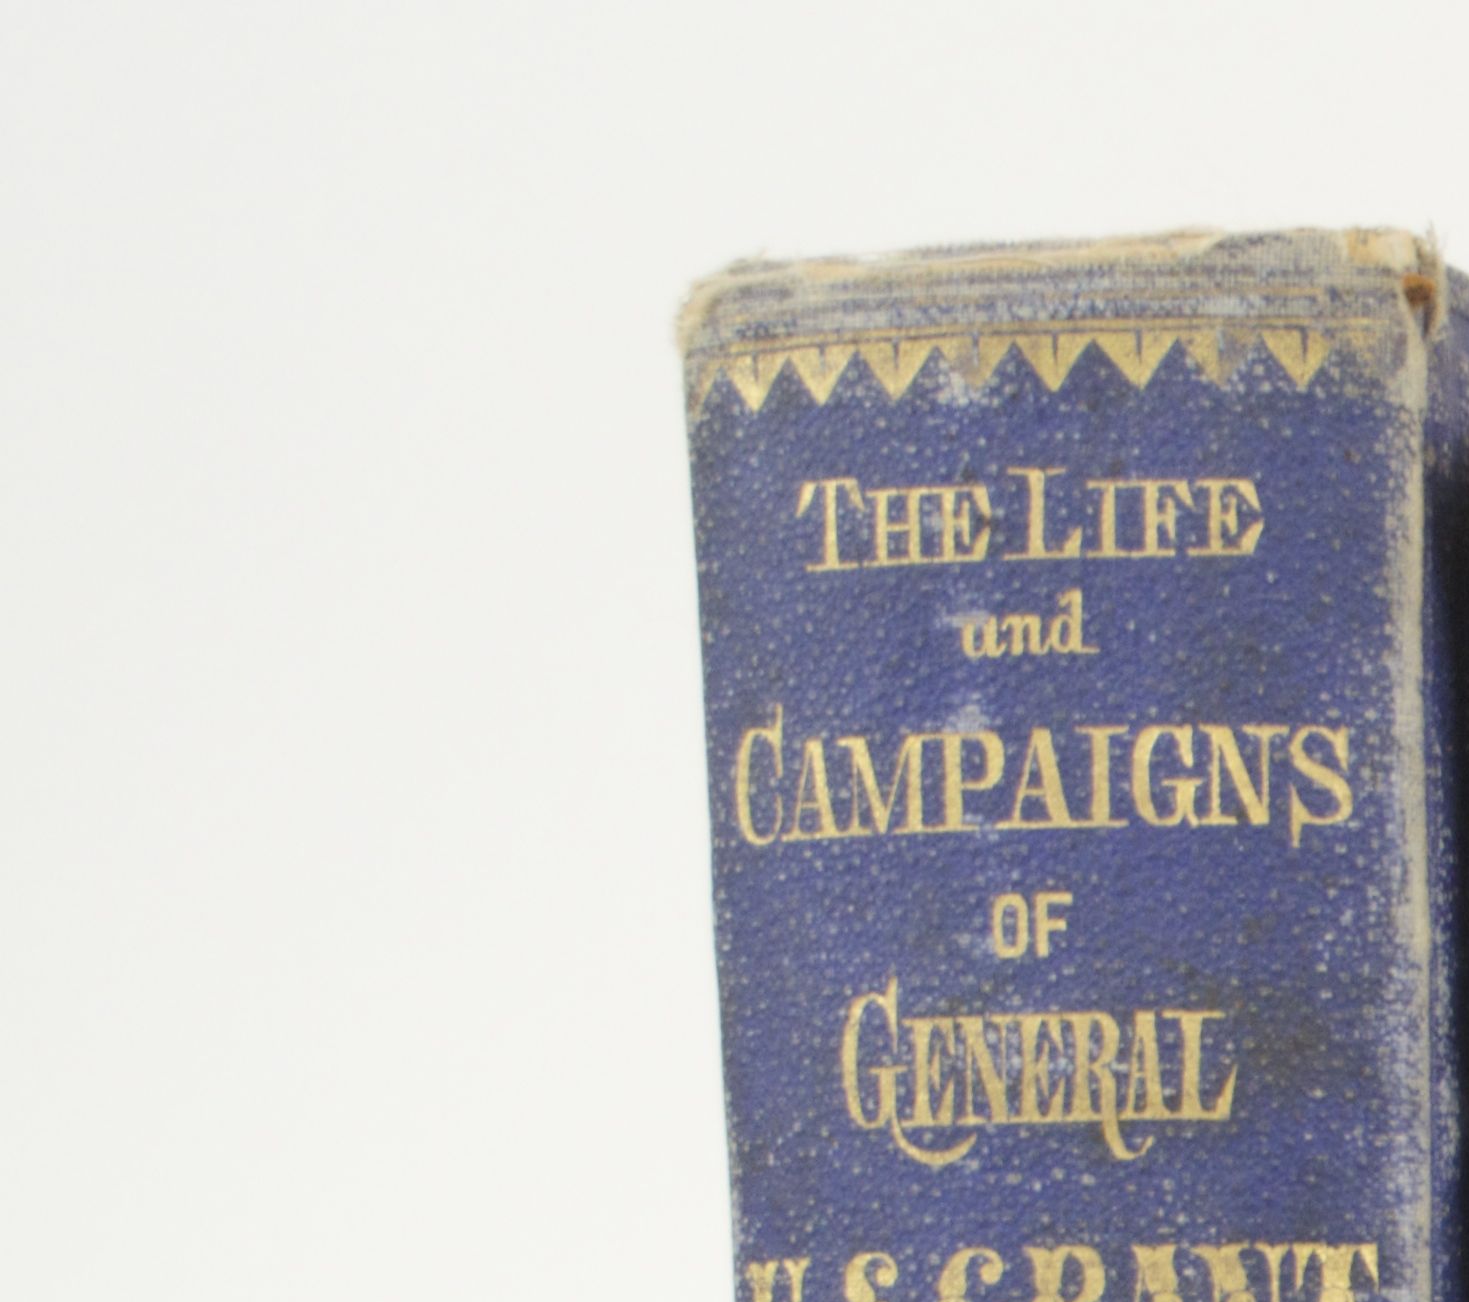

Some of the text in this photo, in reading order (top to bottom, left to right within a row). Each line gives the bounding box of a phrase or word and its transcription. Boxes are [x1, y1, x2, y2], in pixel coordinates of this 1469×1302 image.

[797, 466, 1265, 572] THE LIFE
[961, 589, 1099, 658] and
[735, 703, 1354, 849] CAMPAIGNS
[992, 892, 1073, 958] OF
[841, 976, 1237, 1166] GENERAL
